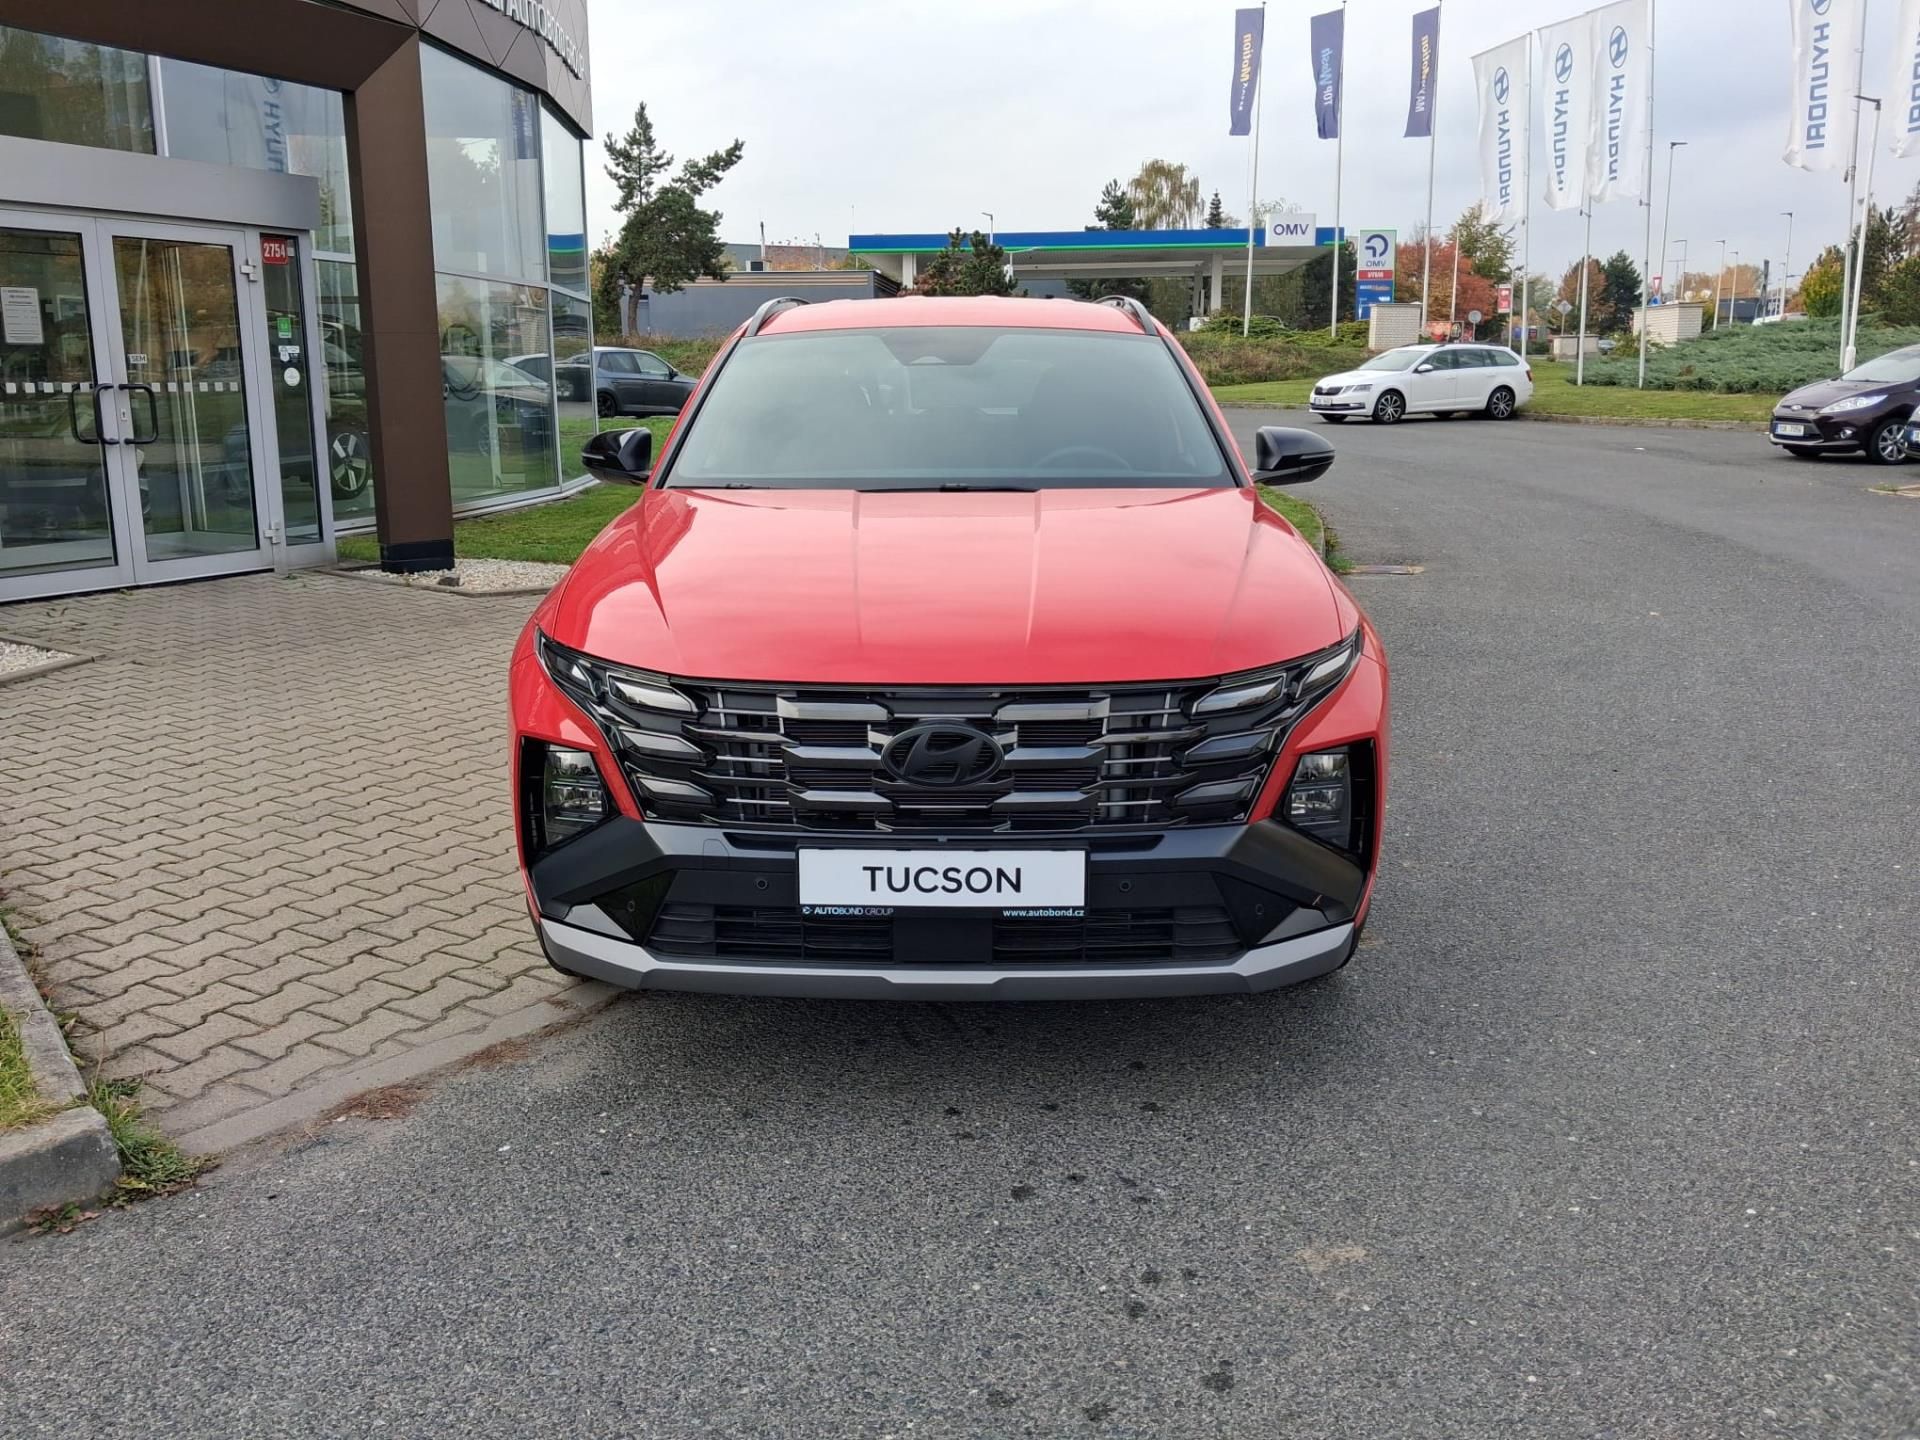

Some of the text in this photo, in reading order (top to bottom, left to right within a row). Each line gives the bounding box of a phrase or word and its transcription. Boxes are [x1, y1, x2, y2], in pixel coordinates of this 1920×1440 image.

[1273, 223, 1310, 236] OMV
[263, 242, 286, 258] 2754
[1365, 260, 1387, 268] OMV
[863, 866, 1022, 894] TUCSON
[814, 906, 894, 916] AUTOBOND GROUP
[1002, 908, 1085, 917] www.autobond.cz
